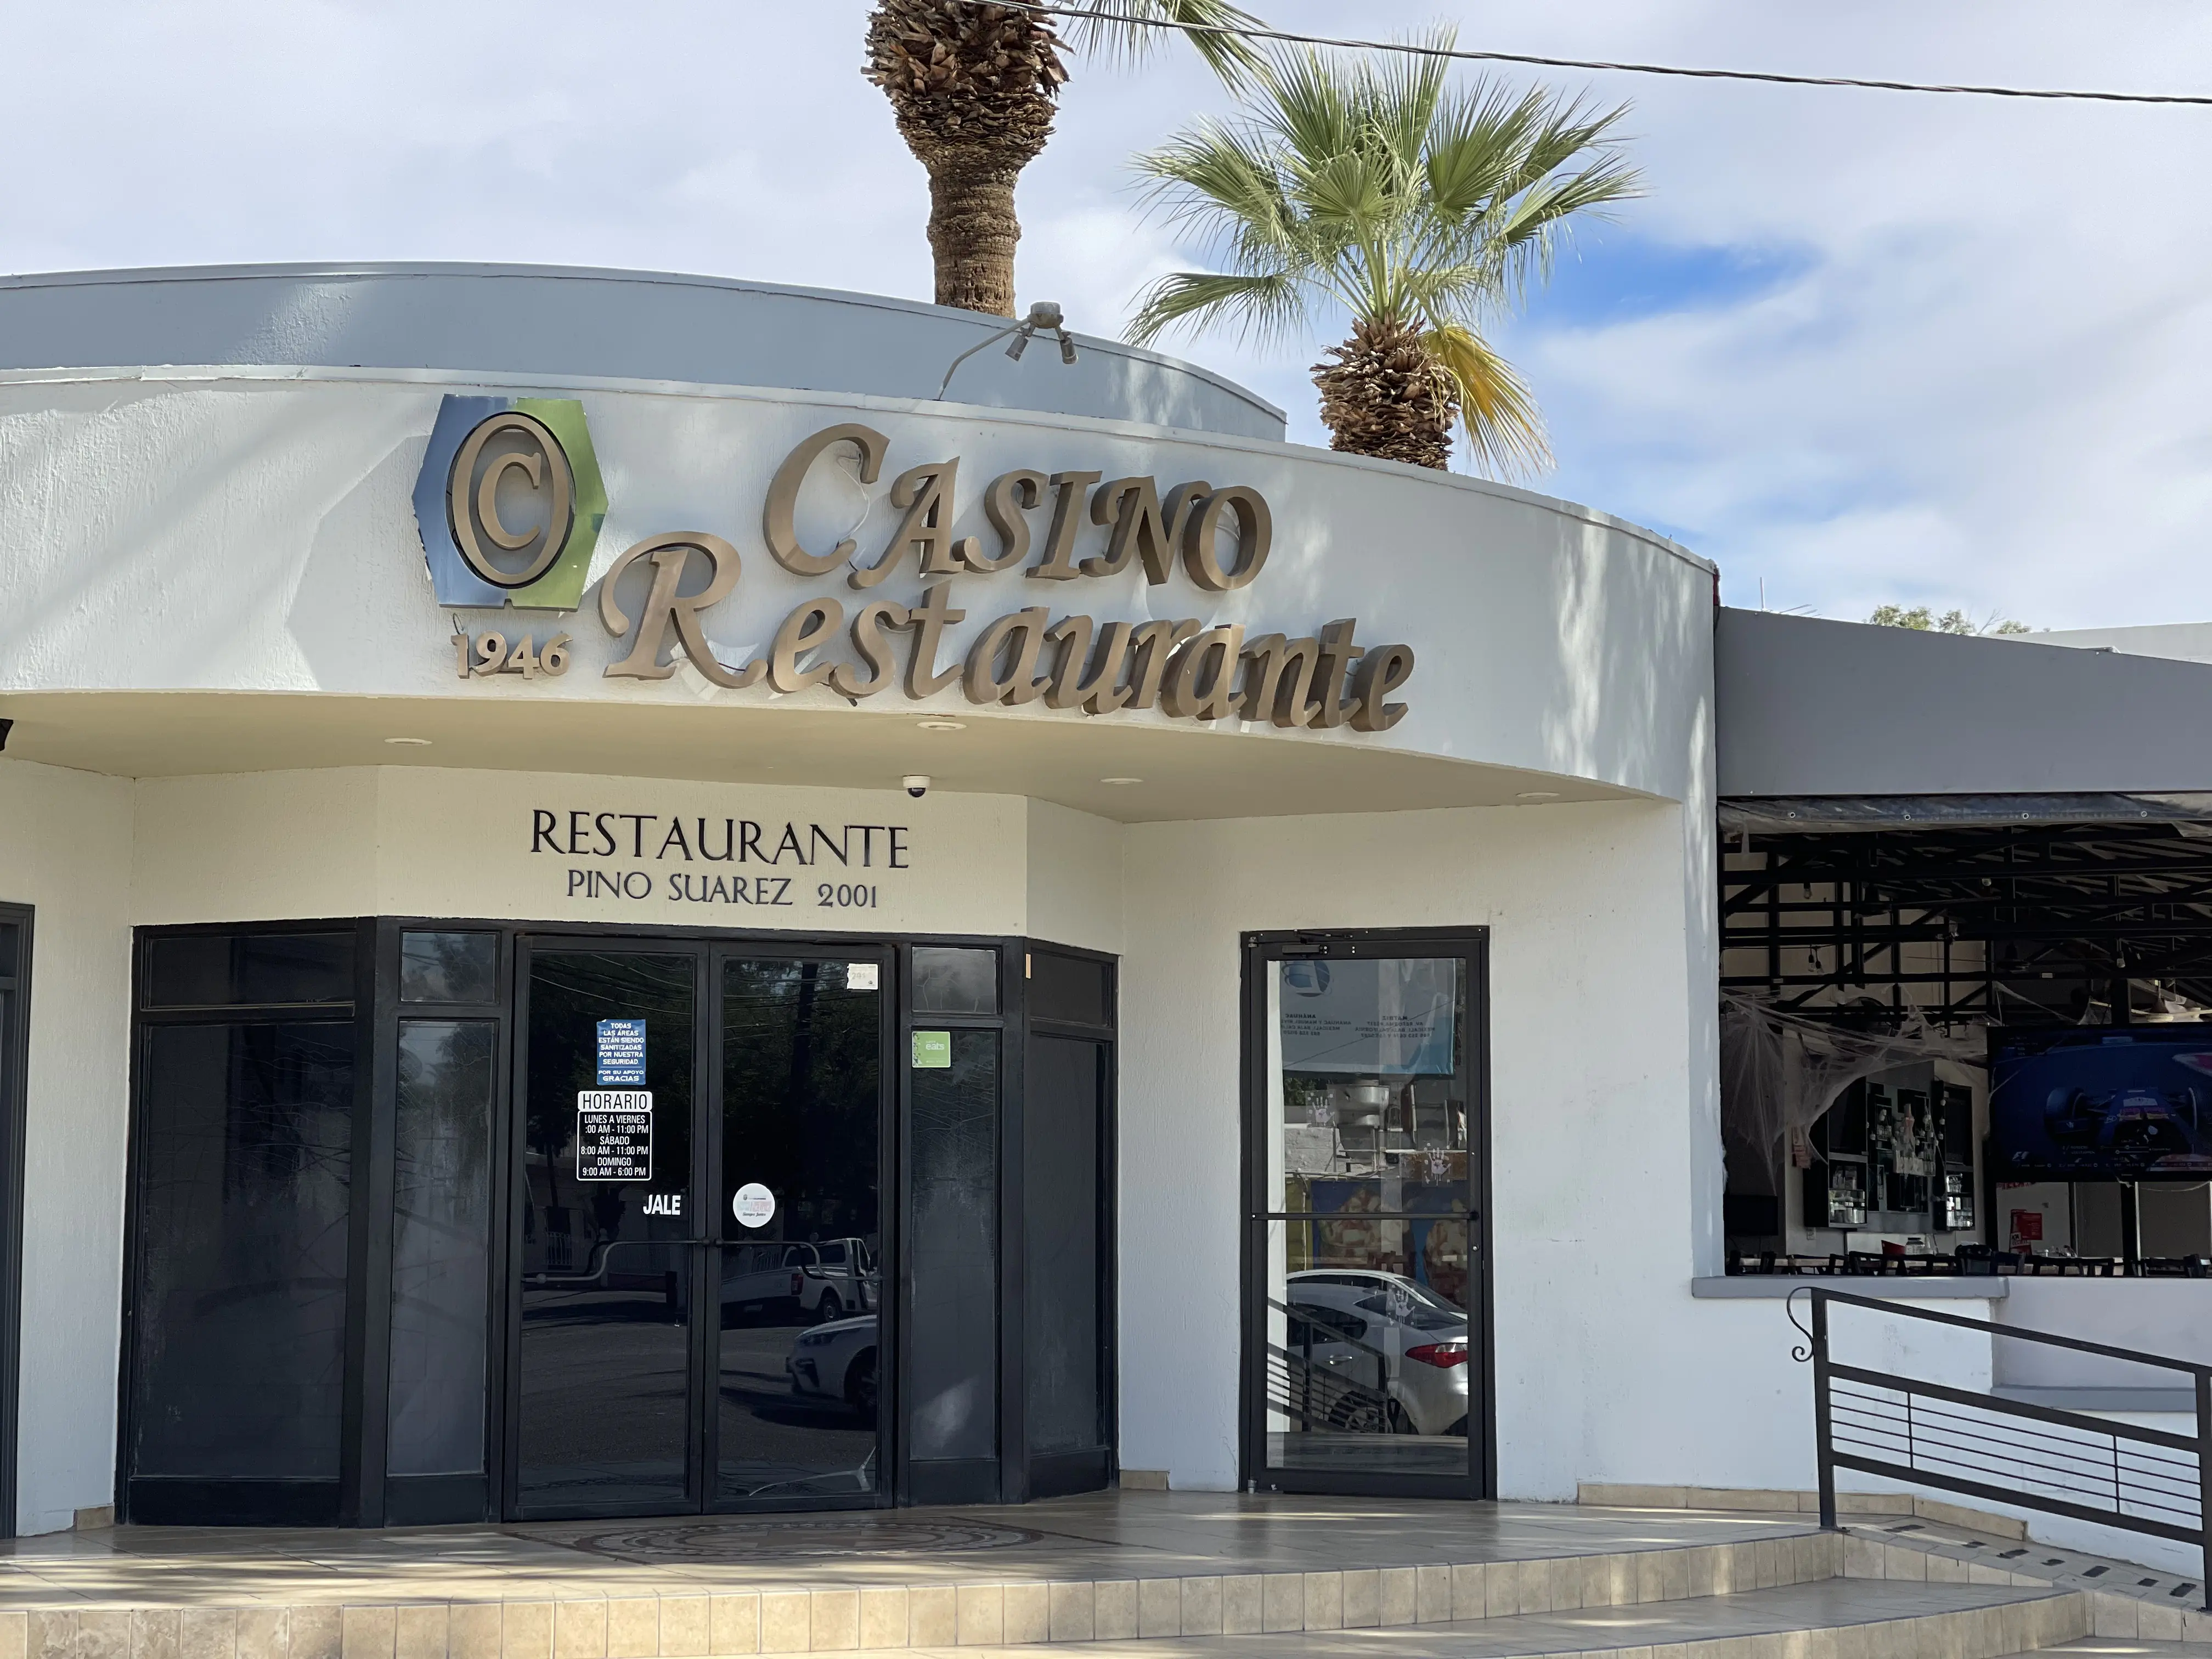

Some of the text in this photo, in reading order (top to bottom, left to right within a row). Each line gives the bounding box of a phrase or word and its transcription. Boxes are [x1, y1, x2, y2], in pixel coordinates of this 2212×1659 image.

[764, 423, 1272, 591] CASINO
[599, 531, 1415, 733] Restaurante
[450, 630, 574, 680] 1946
[531, 810, 909, 869] RESTAURANTE
[567, 870, 877, 909] PINO SUAREZ 2001
[583, 1093, 647, 1110] HORARIO
[584, 1115, 646, 1124] LUNES A VIERNES
[597, 1125, 610, 1133] AM
[617, 1125, 635, 1133] 11:00
[637, 1125, 648, 1133] PM
[600, 1134, 630, 1145] SÁBADO
[580, 1146, 596, 1155] 8:00
[597, 1146, 610, 1155] AM
[617, 1146, 635, 1155] 11:00
[636, 1146, 648, 1155] PM
[597, 1157, 631, 1166] DOMINGO
[582, 1167, 597, 1176] 9:00
[599, 1167, 612, 1176] AM
[618, 1167, 633, 1176] 6:00
[634, 1167, 646, 1176] PM
[642, 1194, 681, 1216] JALE
